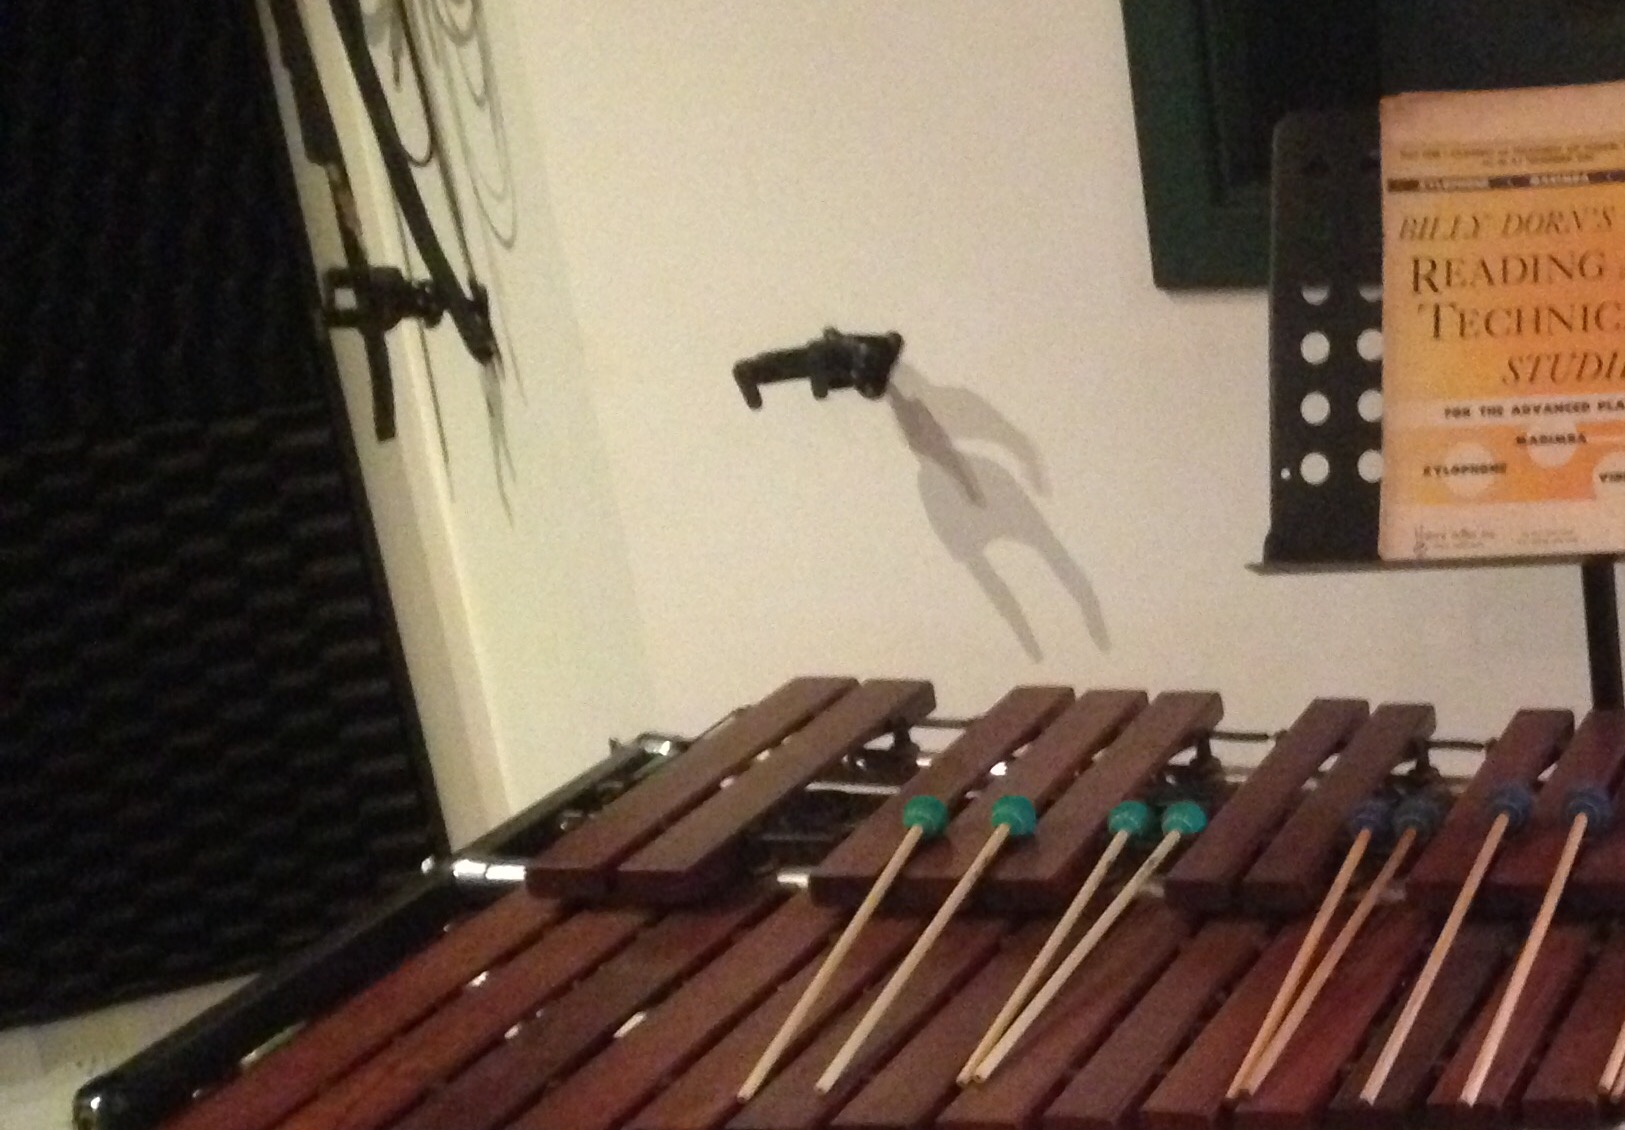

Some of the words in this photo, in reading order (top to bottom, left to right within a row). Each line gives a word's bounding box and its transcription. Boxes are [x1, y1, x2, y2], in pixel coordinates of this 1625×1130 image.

[1411, 251, 1605, 295] READING
[1444, 405, 1471, 419] FOR
[1480, 404, 1504, 418] THE
[1511, 401, 1590, 416] ADVANCED
[1516, 432, 1587, 446] MARIMBA
[1423, 462, 1507, 478] XYLOPHONE
